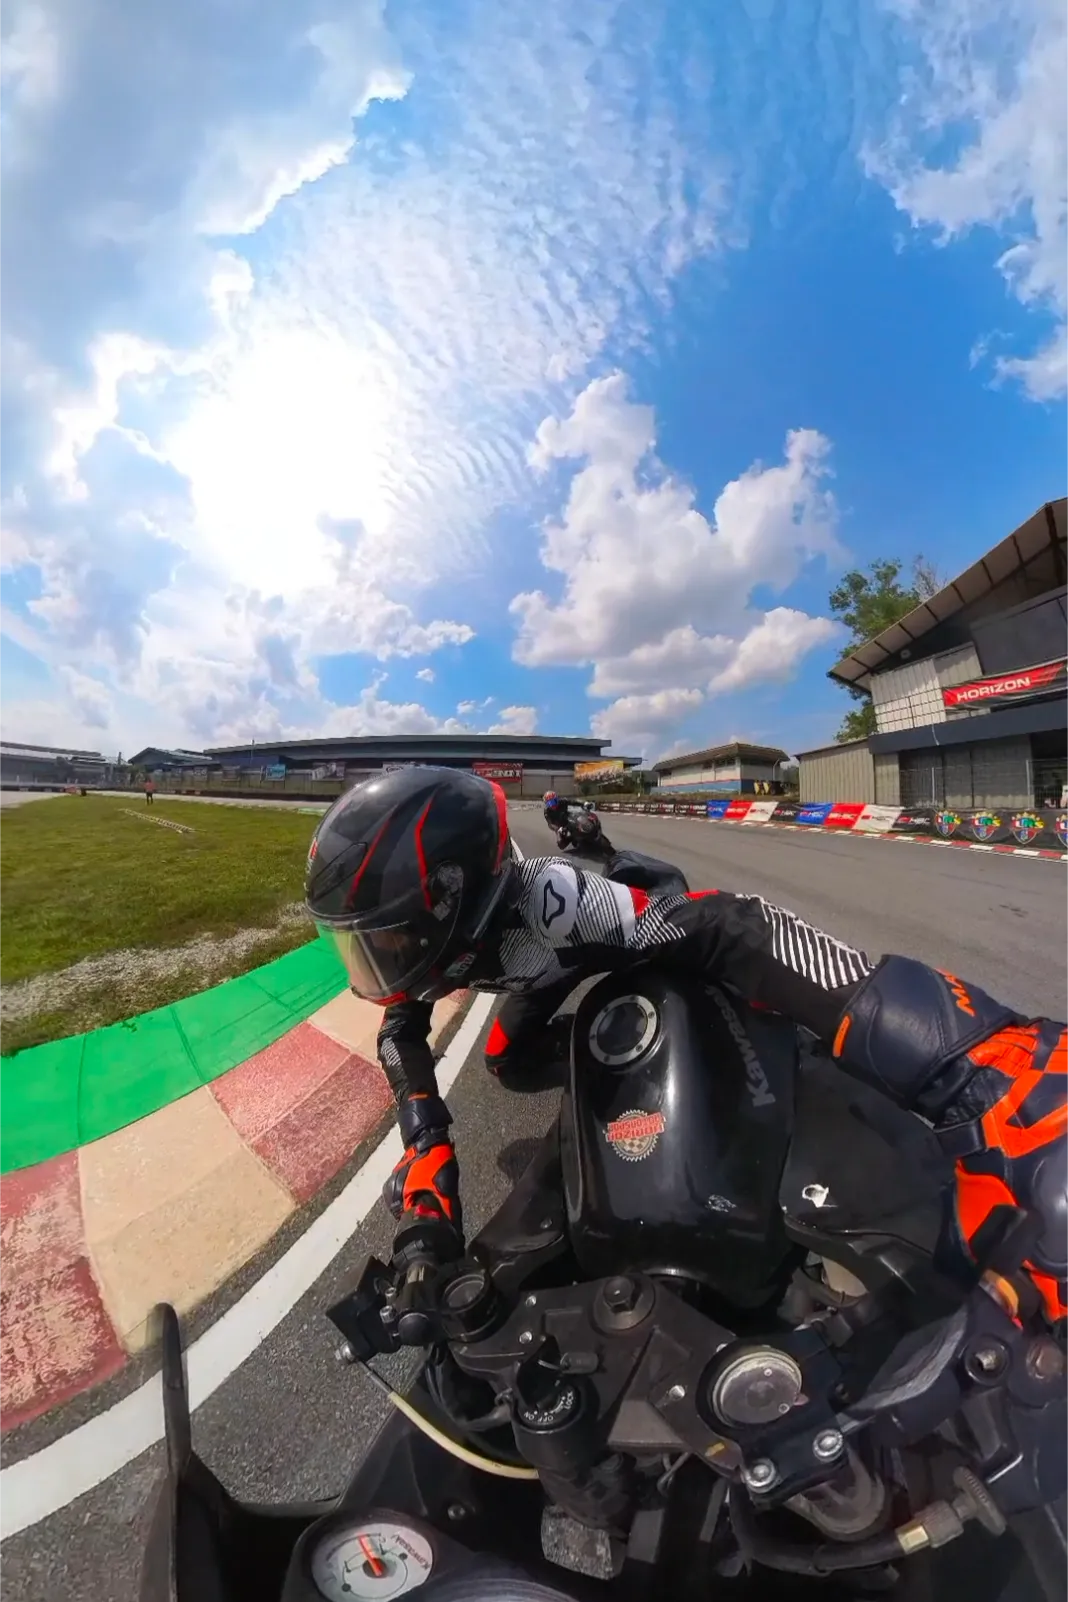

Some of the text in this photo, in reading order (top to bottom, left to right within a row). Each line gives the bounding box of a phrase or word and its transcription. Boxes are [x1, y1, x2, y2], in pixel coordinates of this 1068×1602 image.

[957, 677, 1032, 702] HORIZON
[523, 1411, 535, 1421] ON
[537, 1415, 554, 1423] OFF
